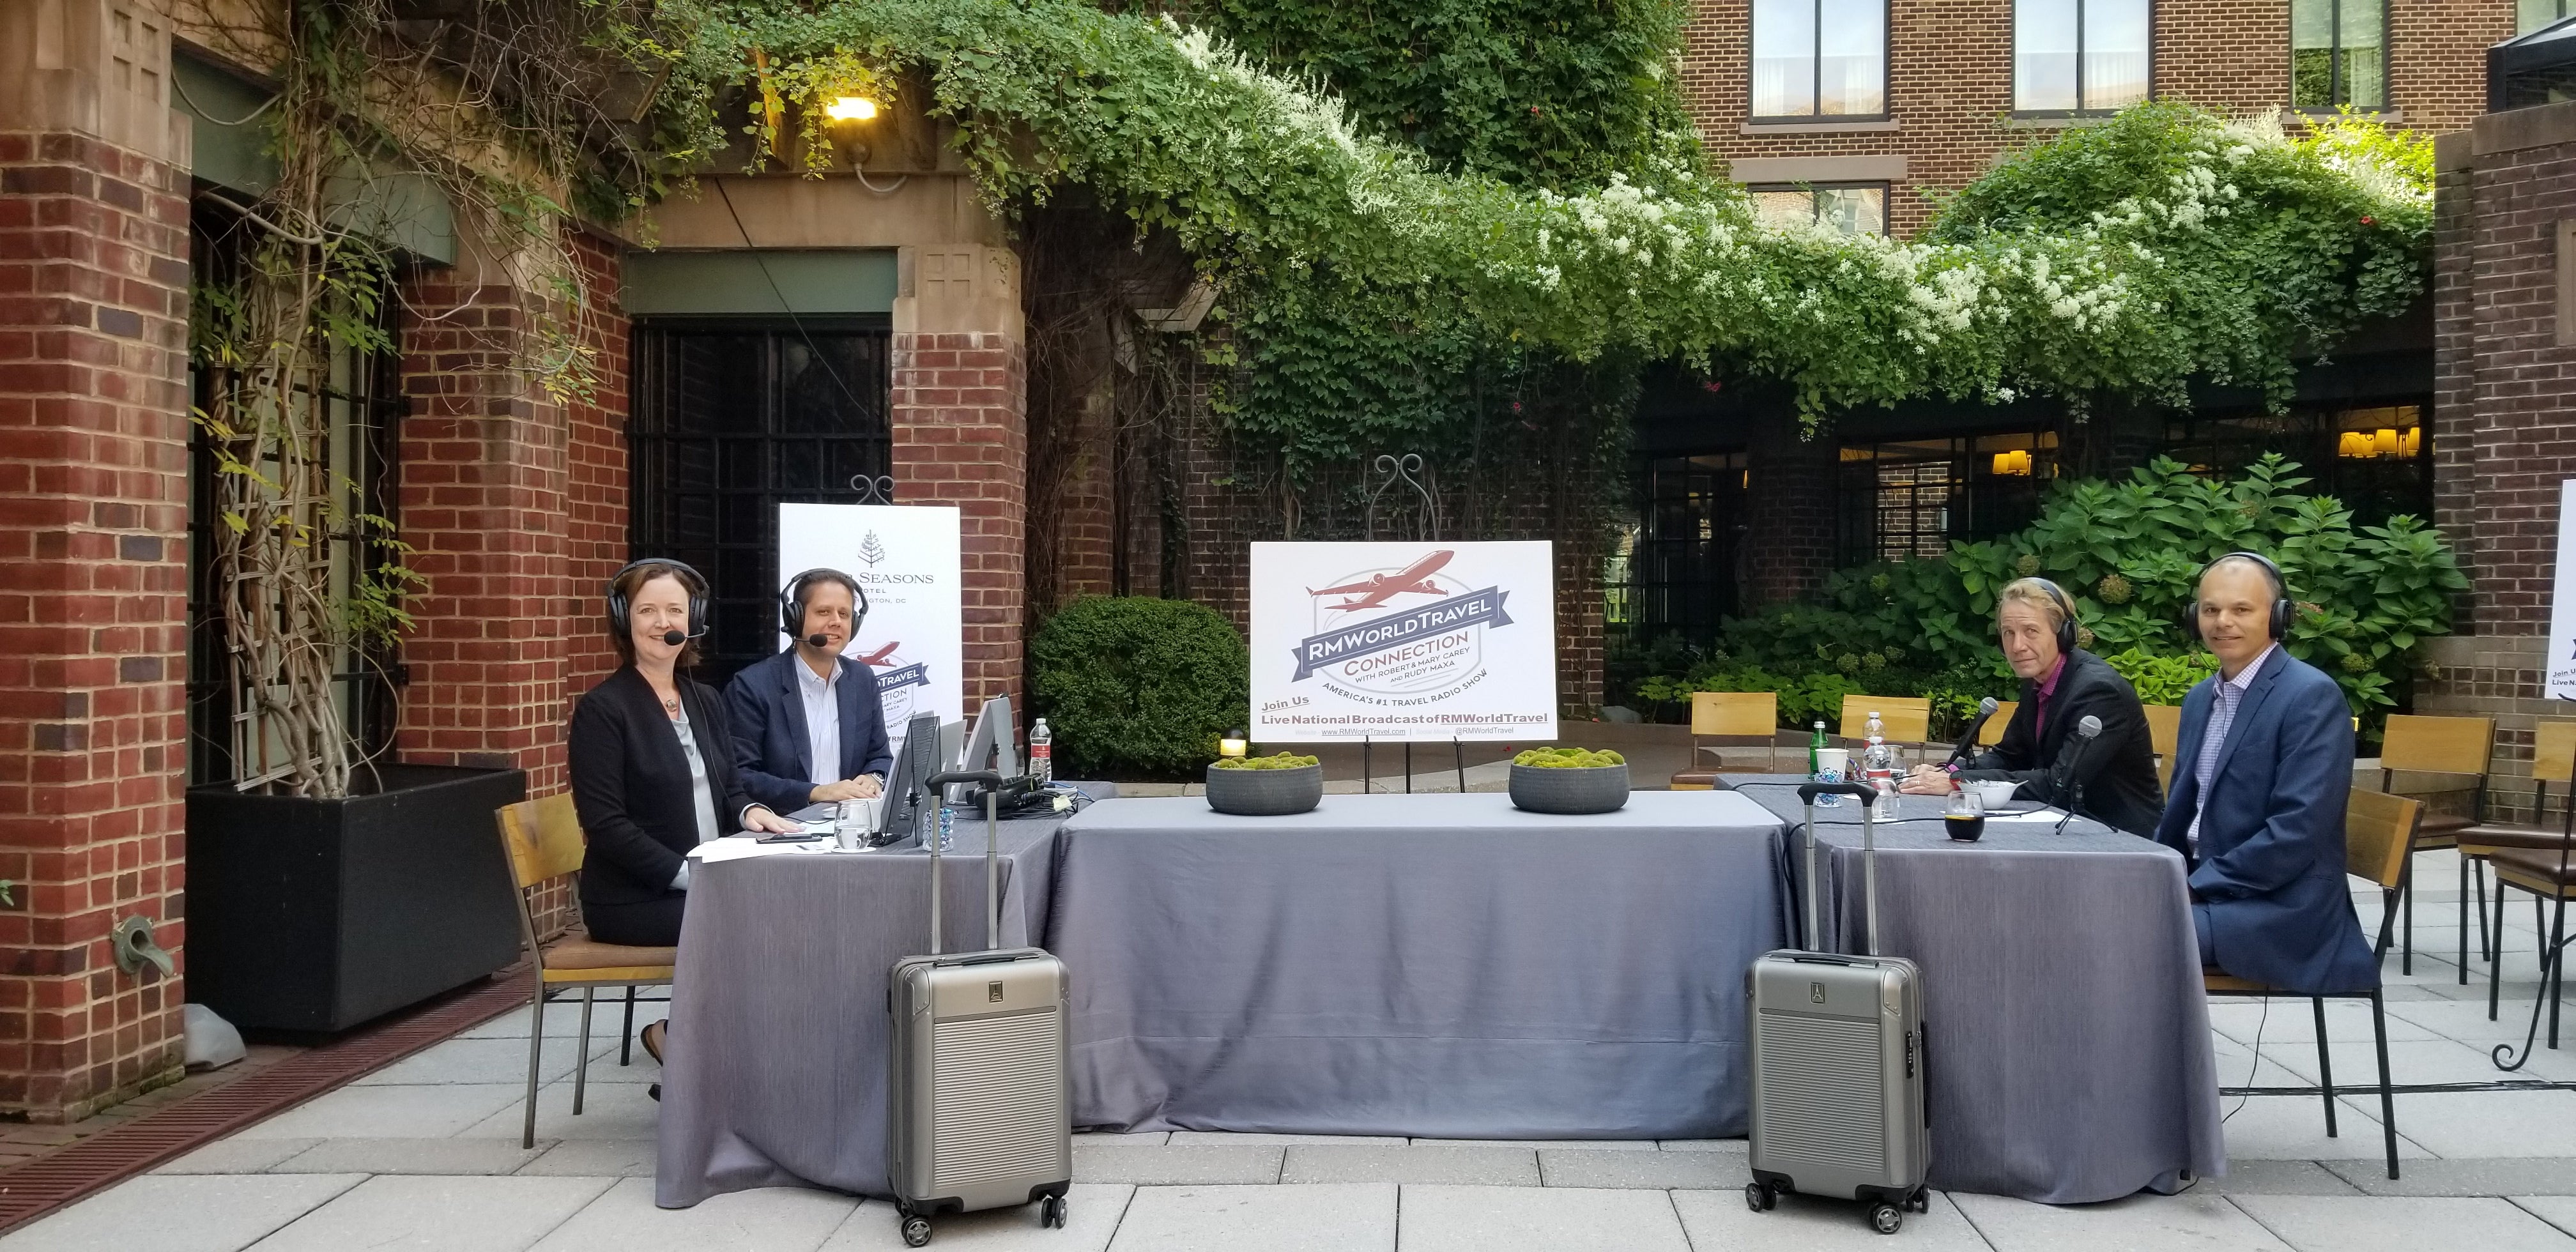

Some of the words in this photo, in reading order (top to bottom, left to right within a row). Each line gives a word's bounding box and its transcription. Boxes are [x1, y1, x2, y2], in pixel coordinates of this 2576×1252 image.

[1355, 673, 1376, 683] WITH
[1378, 663, 1410, 678] ROBERT
[1418, 655, 1441, 667] MARY
[1443, 646, 1471, 659] CAREY
[1404, 668, 1428, 679] RUDY
[1430, 660, 1455, 671] MAXA
[1322, 682, 1374, 704] AMERICA'S
[1392, 697, 1429, 706] TRAVEL
[1430, 687, 1461, 702] RADIO
[1462, 668, 1487, 690] SHOW
[1261, 700, 1289, 712] Join
[1292, 696, 1310, 705] Us
[886, 720, 903, 729] RADIO
[1261, 715, 1290, 724] Live
[1291, 715, 1350, 724] National
[1352, 714, 1425, 724] Broadcast
[1425, 714, 1440, 723] of
[1440, 713, 1548, 723] RMWorldTravel
[1321, 728, 1406, 736] www.RMWorldTravel.com
[1455, 726, 1514, 735] @RMWorldTravel
